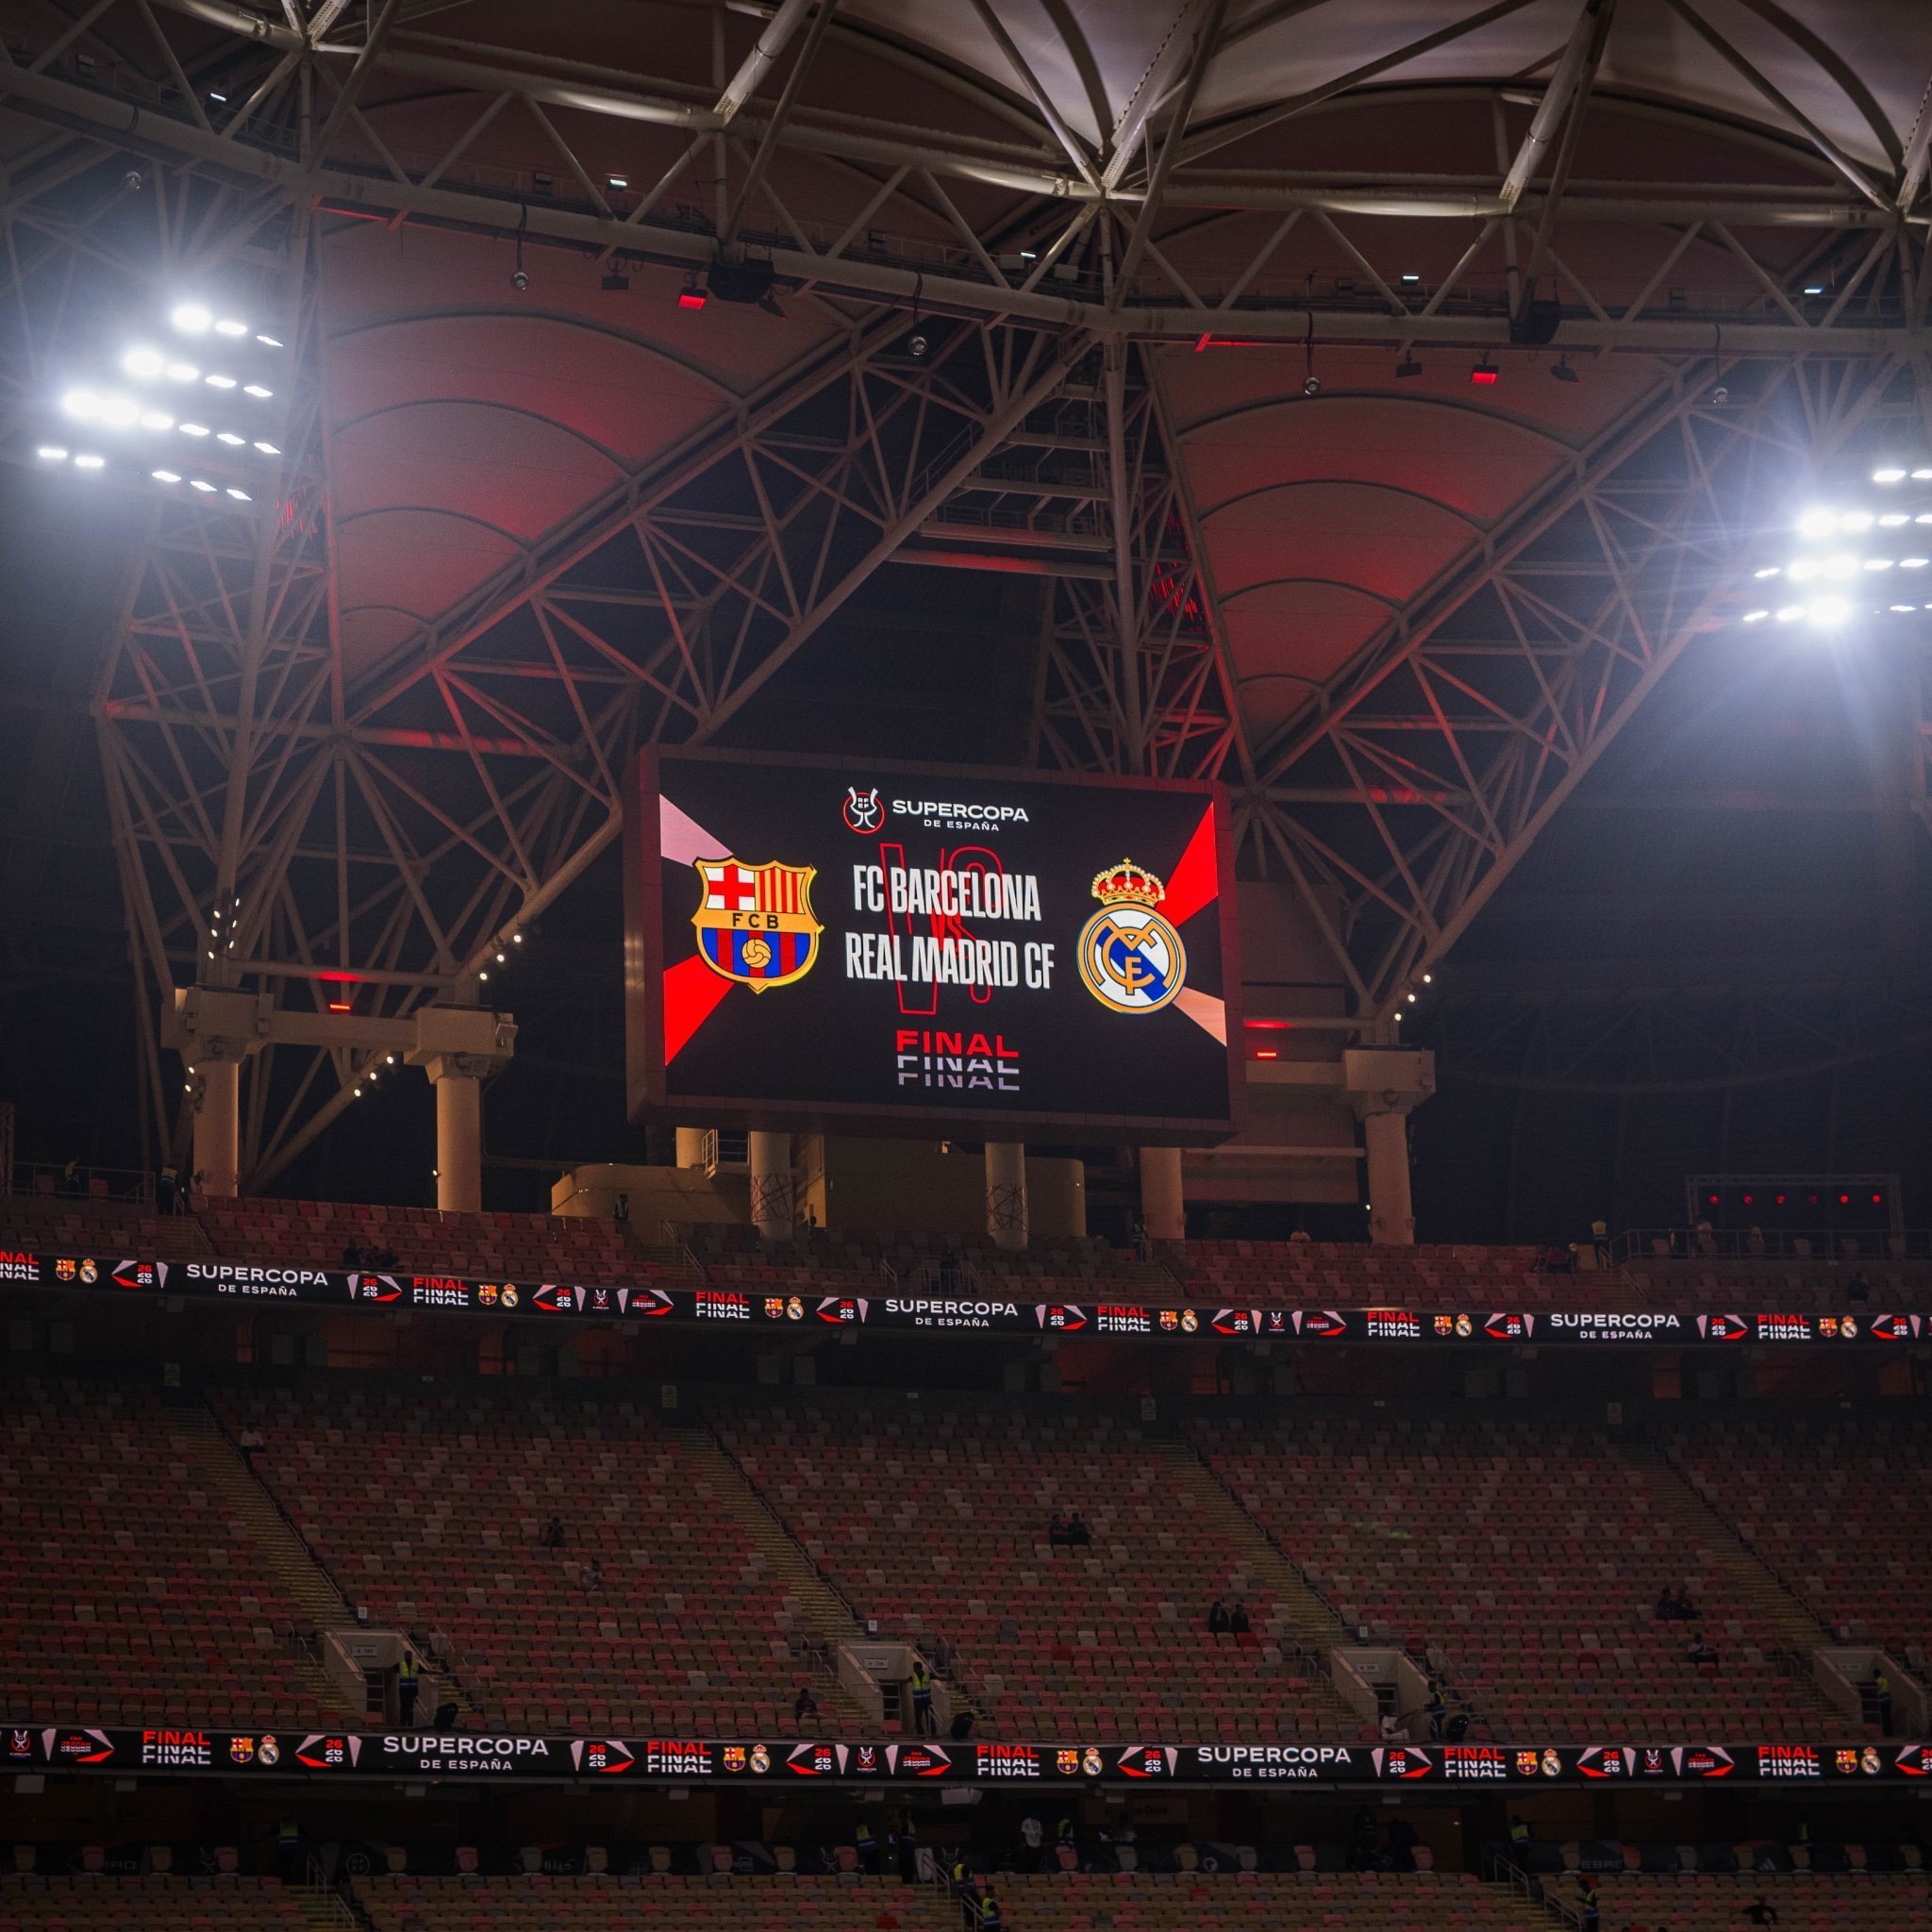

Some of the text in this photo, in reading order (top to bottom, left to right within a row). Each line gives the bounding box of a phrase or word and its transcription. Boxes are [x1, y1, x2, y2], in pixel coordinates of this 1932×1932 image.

[892, 799, 1029, 823] SUPERCOPA
[924, 819, 1000, 832] DE ESPAÑA
[854, 864, 1042, 922] FC BARCELONA
[732, 912, 779, 929] FCB
[845, 931, 1055, 990] REAL MADRID CF
[896, 1029, 1020, 1058] FINAL
[0, 1252, 39, 1264] NAL
[137, 1264, 153, 1273] 26
[186, 1263, 328, 1286] SUPERCOPA
[362, 1277, 378, 1286] 26
[413, 1276, 469, 1290] FINAL
[219, 1285, 297, 1297] DE ESPAÑA
[695, 1291, 750, 1304] FINAL
[886, 1298, 1019, 1317] SUPERCOPA
[1097, 1305, 1151, 1317] FINAL
[916, 1317, 990, 1327] DE ESPAÑA
[1367, 1310, 1421, 1322] FINAL
[1550, 1313, 1680, 1328] SUPERCOPA
[1757, 1314, 1811, 1325] FINAL
[1892, 1317, 1908, 1325] 26
[1579, 1328, 1653, 1340] DE ESPAÑA
[142, 1730, 211, 1745] FINAL
[325, 1739, 343, 1749] 26
[383, 1736, 549, 1756] SUPERCOPA
[589, 1744, 607, 1754] 26
[647, 1740, 712, 1755] FINAL
[814, 1748, 832, 1757] 26
[977, 1744, 1040, 1758] FINAL
[1444, 1746, 1507, 1759] FINAL
[1758, 1745, 1821, 1758] FINAL
[1144, 1750, 1162, 1759] 26
[1197, 1746, 1352, 1763] SUPERCOPA
[1389, 1751, 1406, 1760] 26
[1603, 1751, 1621, 1760] 26
[420, 1757, 512, 1771] DE ESPAÑA
[1232, 1765, 1318, 1778] DE ESPAÑA
